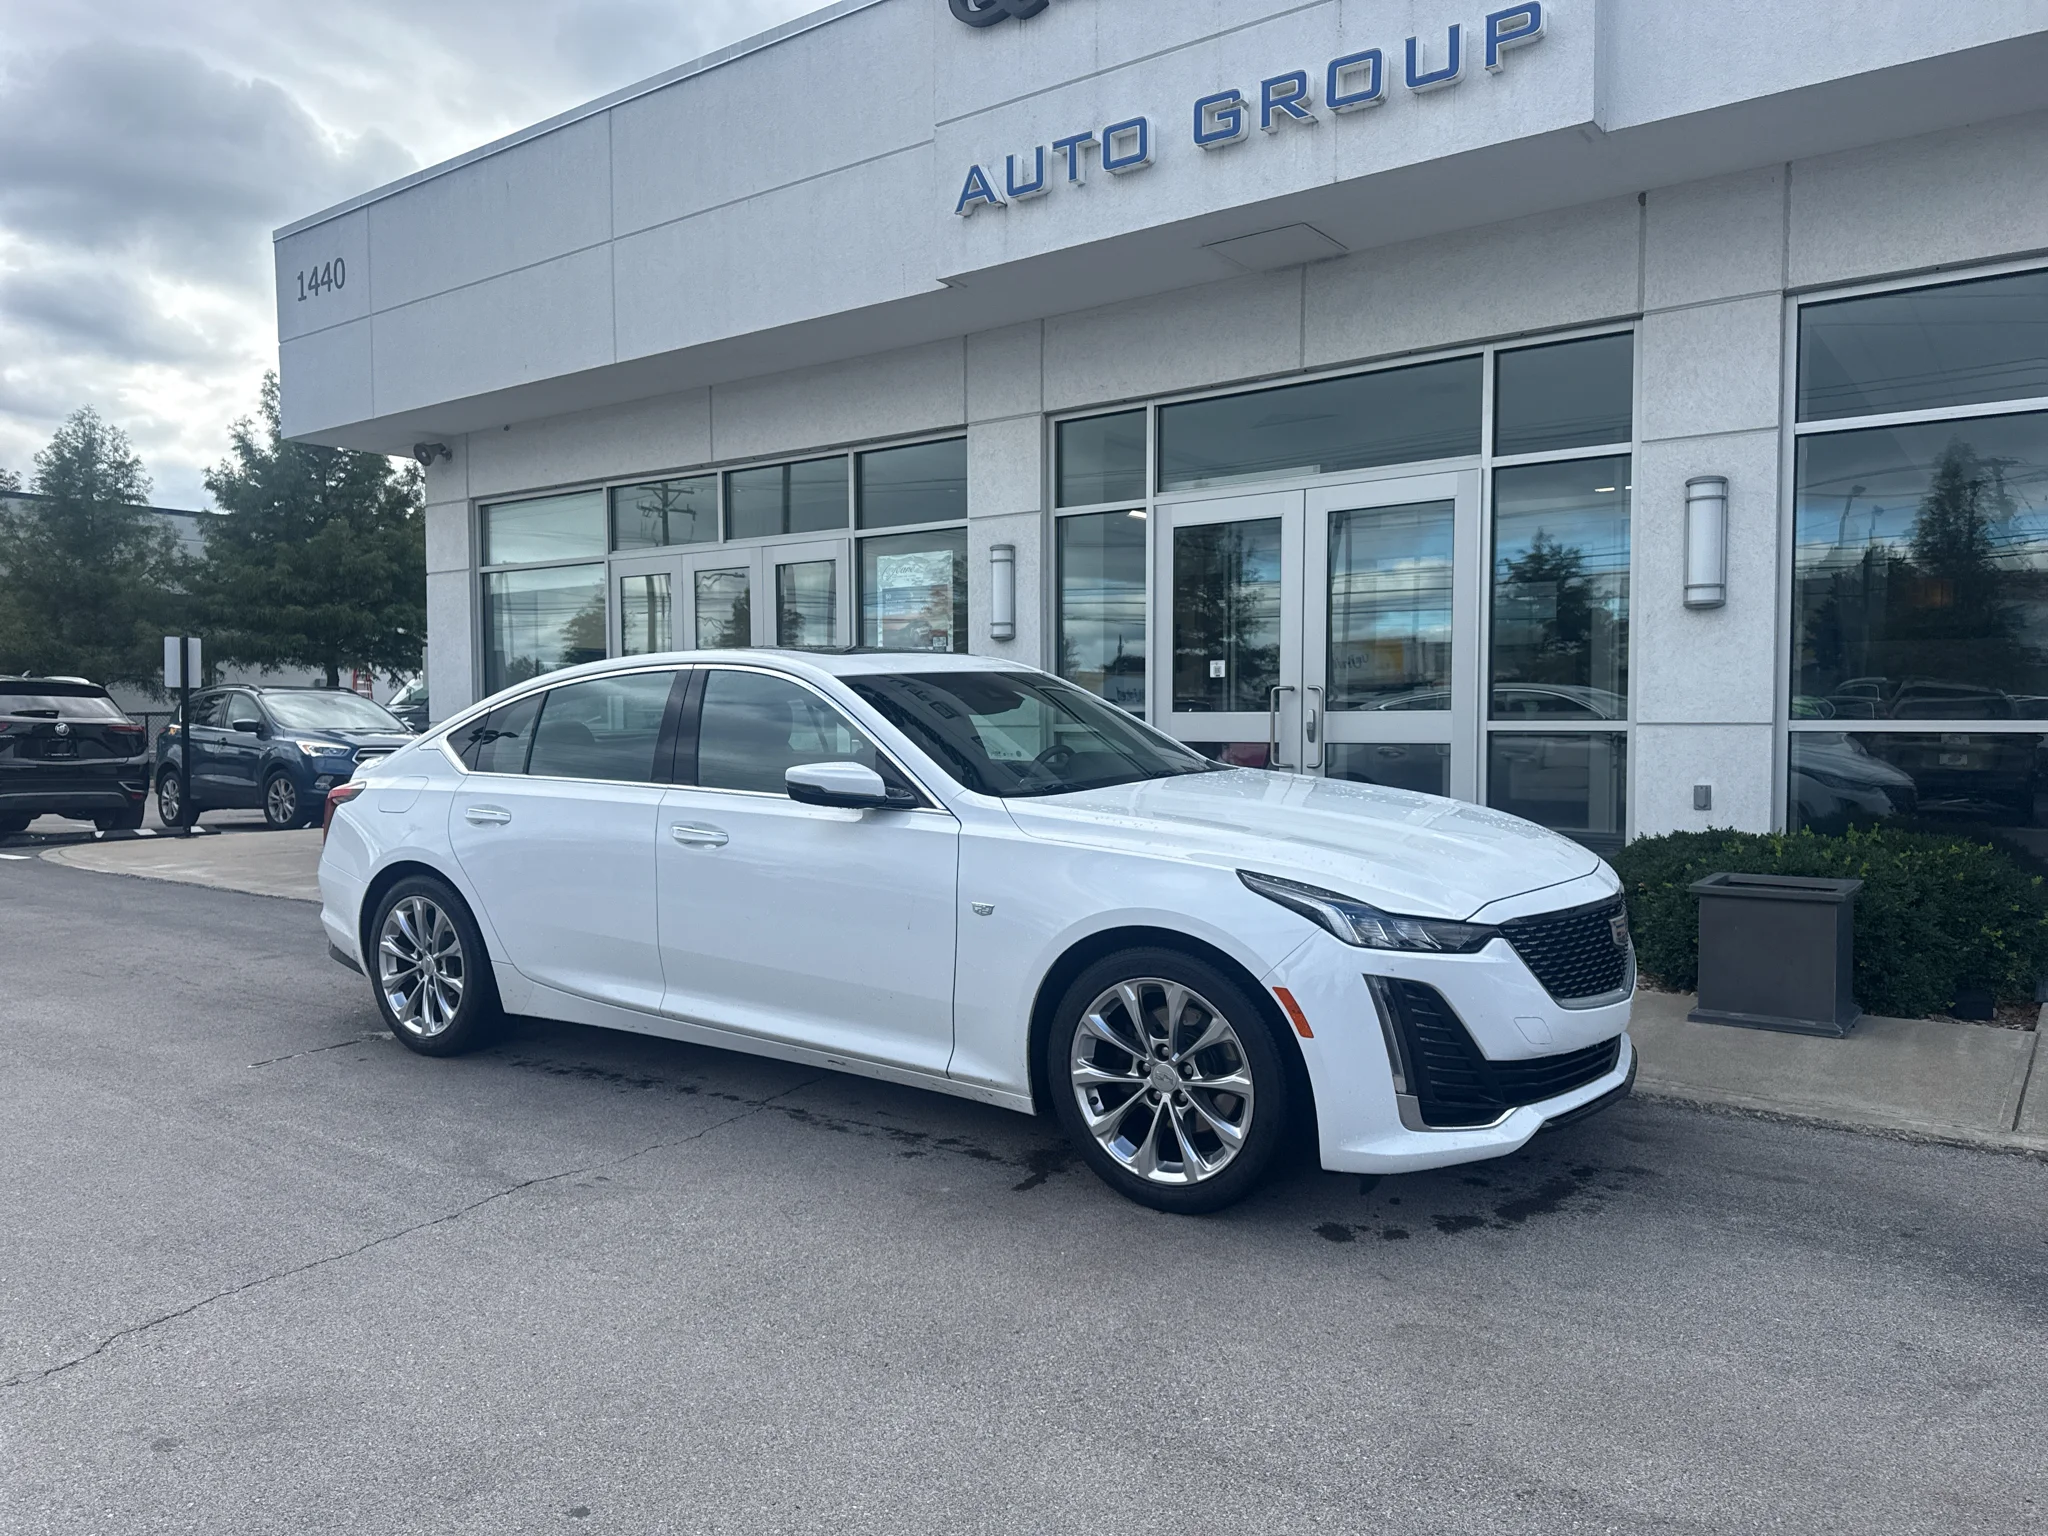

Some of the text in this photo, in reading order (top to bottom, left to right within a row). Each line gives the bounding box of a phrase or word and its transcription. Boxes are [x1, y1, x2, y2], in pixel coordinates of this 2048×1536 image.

[955, 1, 1547, 216] AUTO GROUP
[297, 257, 346, 302] 1440
